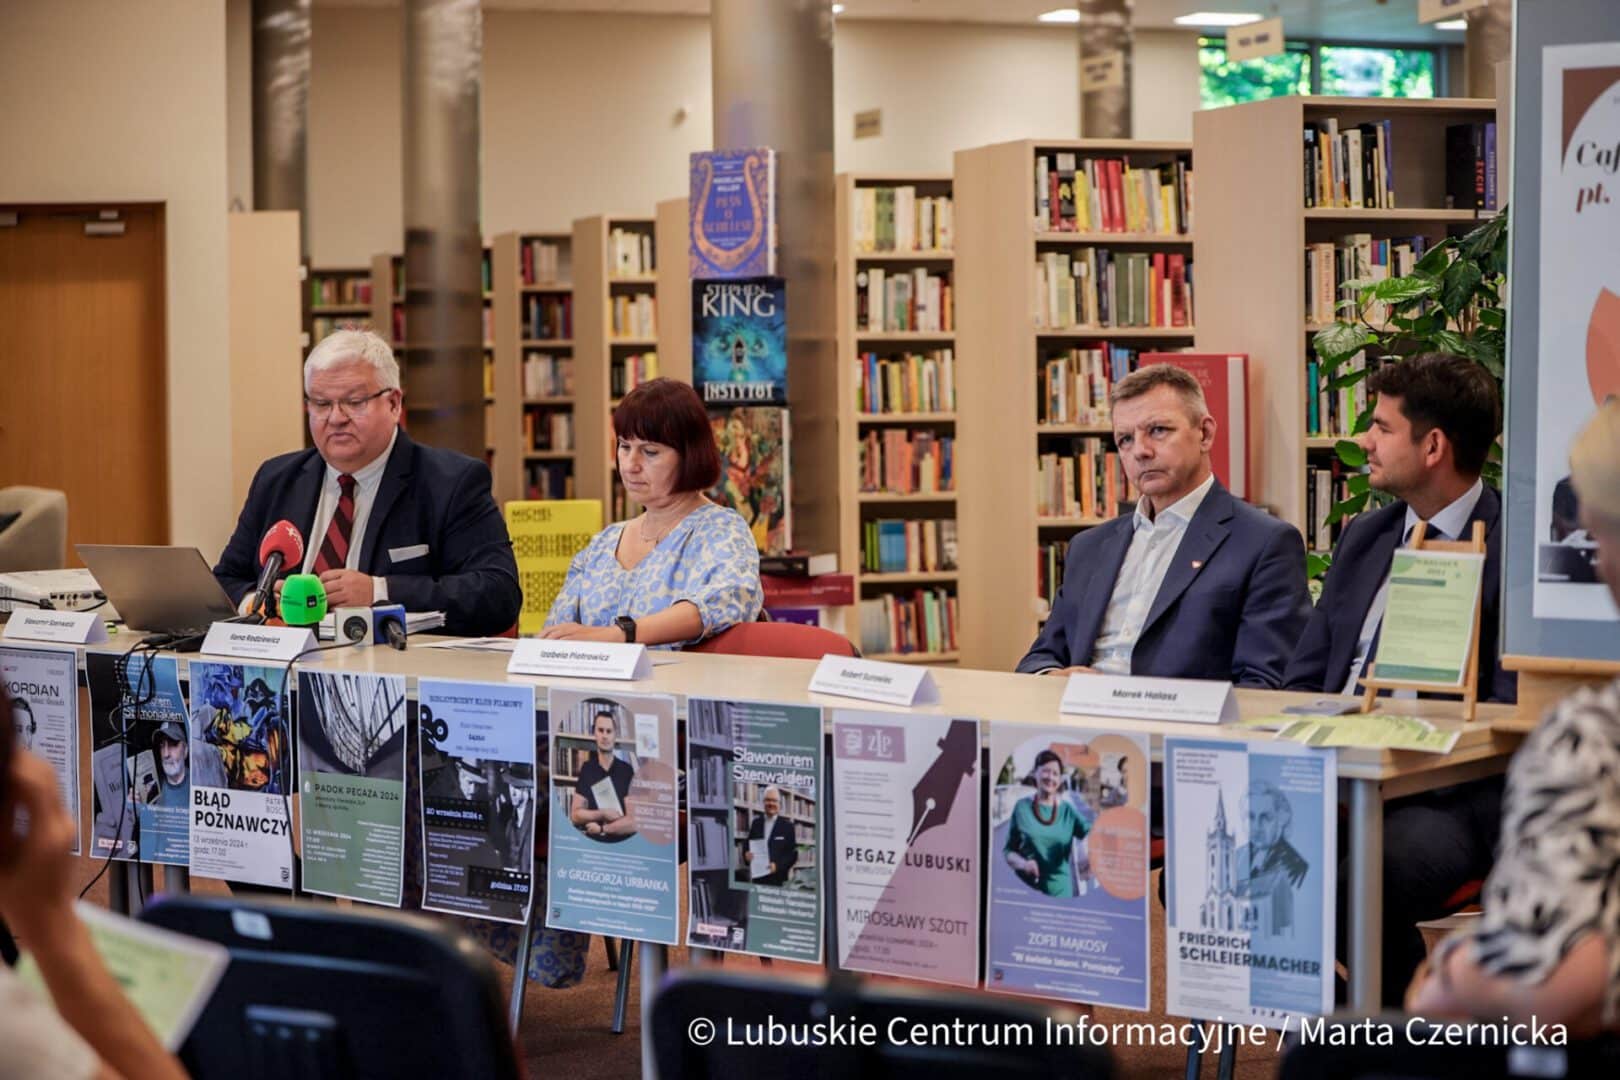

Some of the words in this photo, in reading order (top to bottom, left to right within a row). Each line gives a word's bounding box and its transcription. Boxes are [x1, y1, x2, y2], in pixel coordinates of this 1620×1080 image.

[1575, 182, 1610, 213] pt.
[701, 293, 776, 318] KING
[569, 651, 611, 662] Piotrowicz
[194, 790, 231, 811] BŁĄD
[346, 787, 378, 799] PEGAZA
[380, 790, 400, 802] 2024
[195, 810, 289, 837] POZNAWCZY
[845, 847, 896, 865] PEGAZ
[905, 852, 971, 873] LUBUSKI
[568, 869, 624, 887] GRZEGORZA
[625, 876, 670, 894] URBANKA
[847, 908, 926, 930] MIROSŁAWY
[928, 917, 969, 936] SZOTT
[1028, 931, 1058, 948] ZOFII
[1060, 935, 1109, 955] MĄKOSY
[1178, 931, 1251, 951] FRIEDRICH
[1179, 945, 1321, 976] SCHLEIERMACHER
